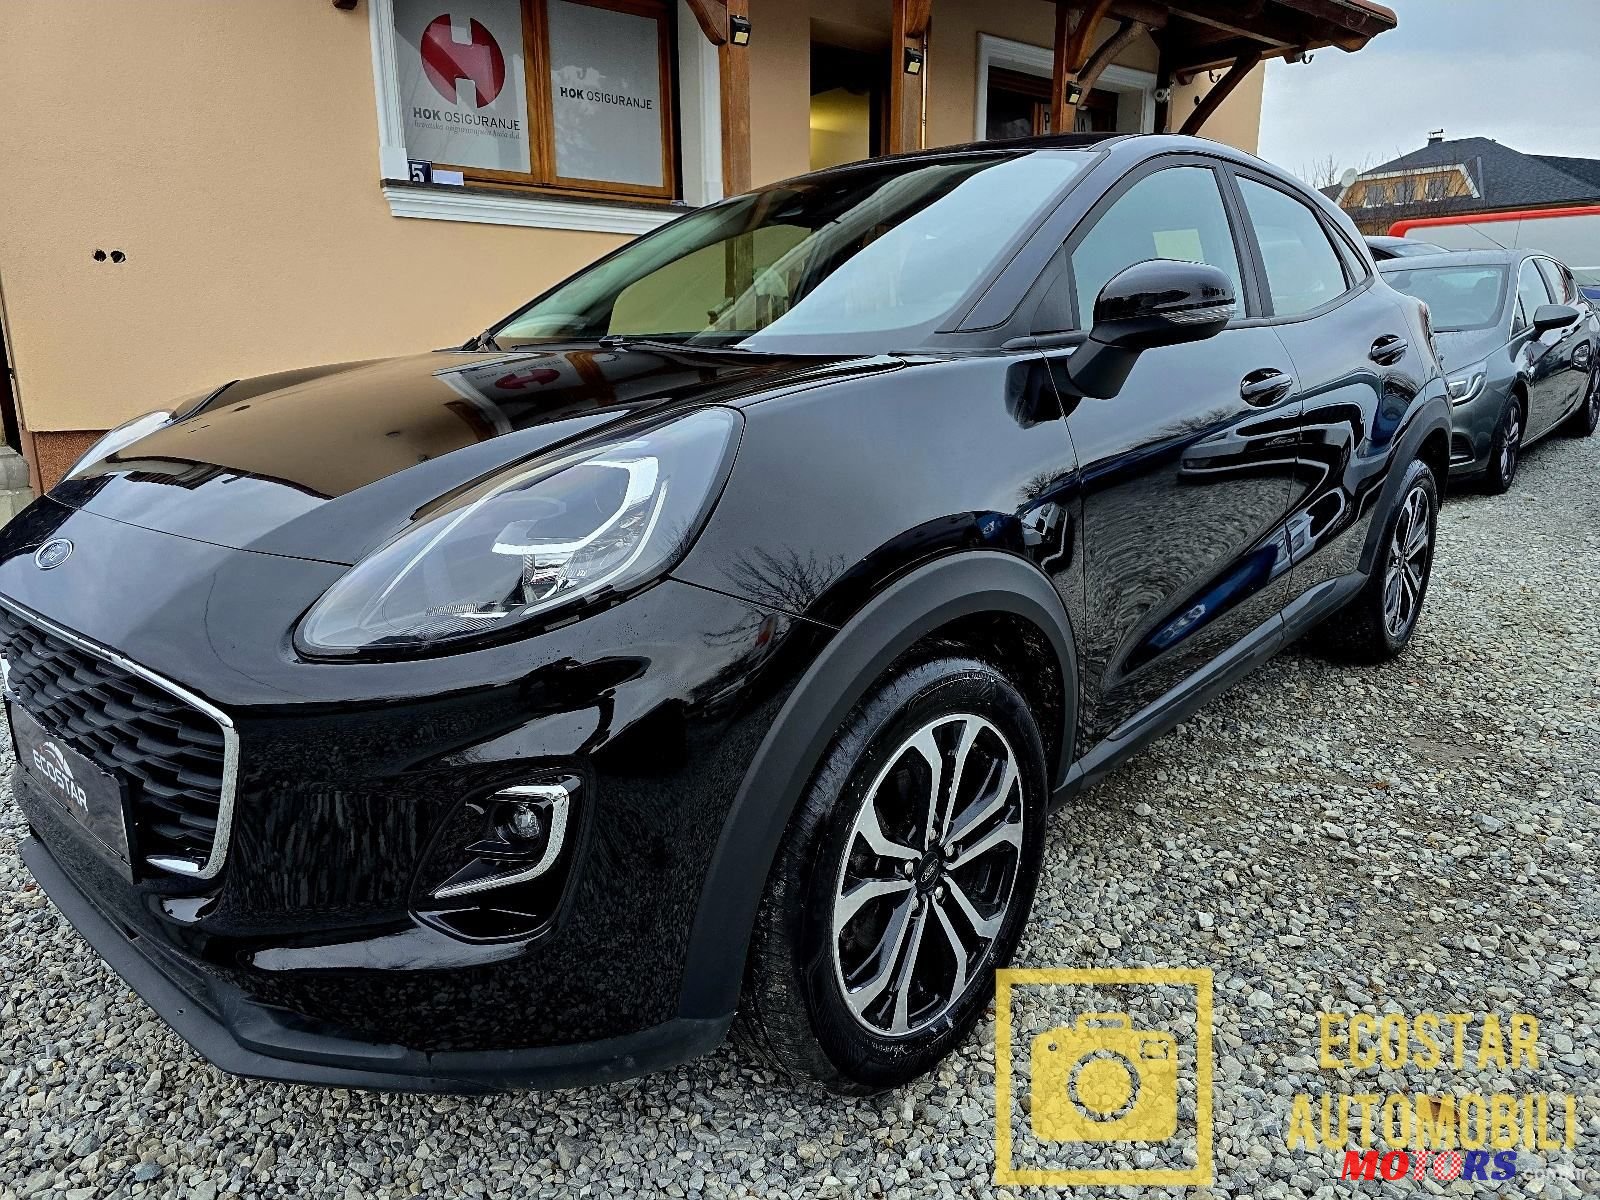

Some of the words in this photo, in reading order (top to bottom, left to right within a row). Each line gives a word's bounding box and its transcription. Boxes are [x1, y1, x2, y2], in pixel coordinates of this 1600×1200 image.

[560, 86, 584, 100] HOK
[586, 91, 653, 110] OSIGURANJE
[413, 107, 441, 121] HOK
[444, 111, 521, 131] OSIGURANJE
[411, 163, 425, 183] 5
[32, 748, 89, 812] ECOSTAR
